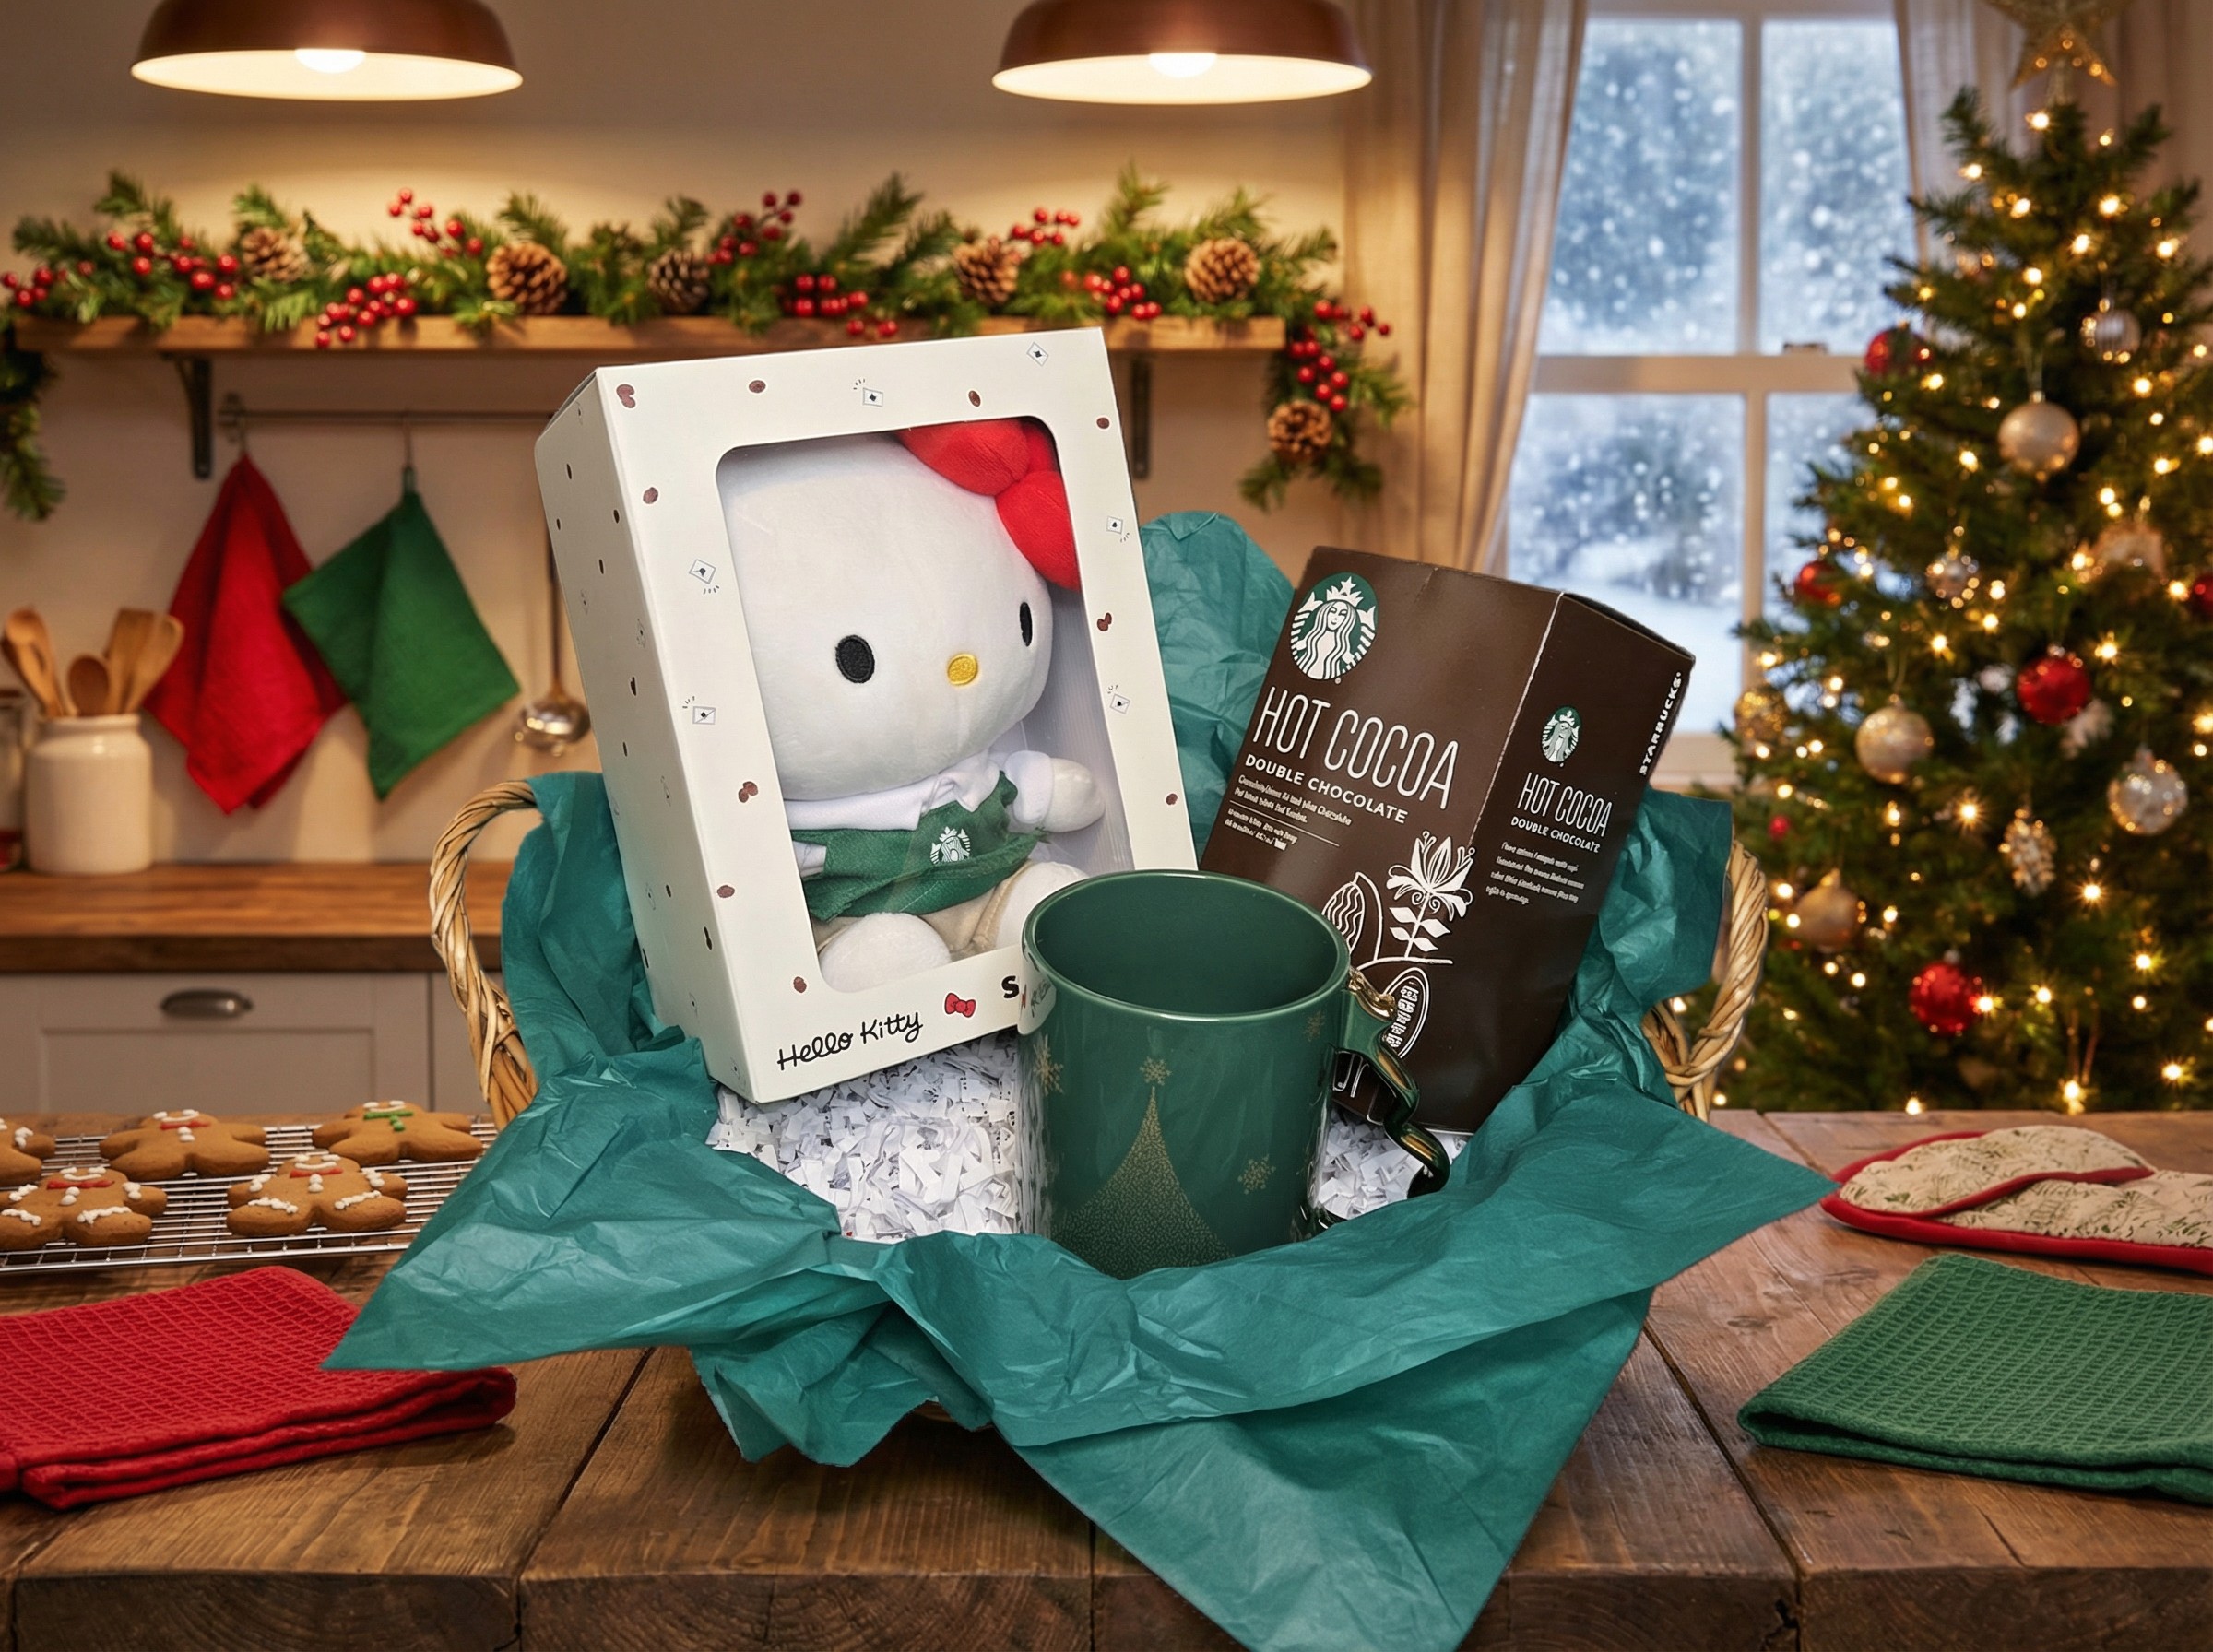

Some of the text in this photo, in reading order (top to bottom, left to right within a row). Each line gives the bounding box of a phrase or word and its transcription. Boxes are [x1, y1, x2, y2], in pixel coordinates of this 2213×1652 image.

[1252, 686, 1331, 760] HOT
[1324, 709, 1459, 809] COCOA
[1245, 754, 1306, 785] DOUBLE
[1308, 777, 1409, 824] CHOCOLATE
[1517, 772, 1613, 837] HOT COCOA
[1510, 816, 1601, 854] DOUBLE CHOCOLATE
[777, 1012, 923, 1070] Hello Kitty
